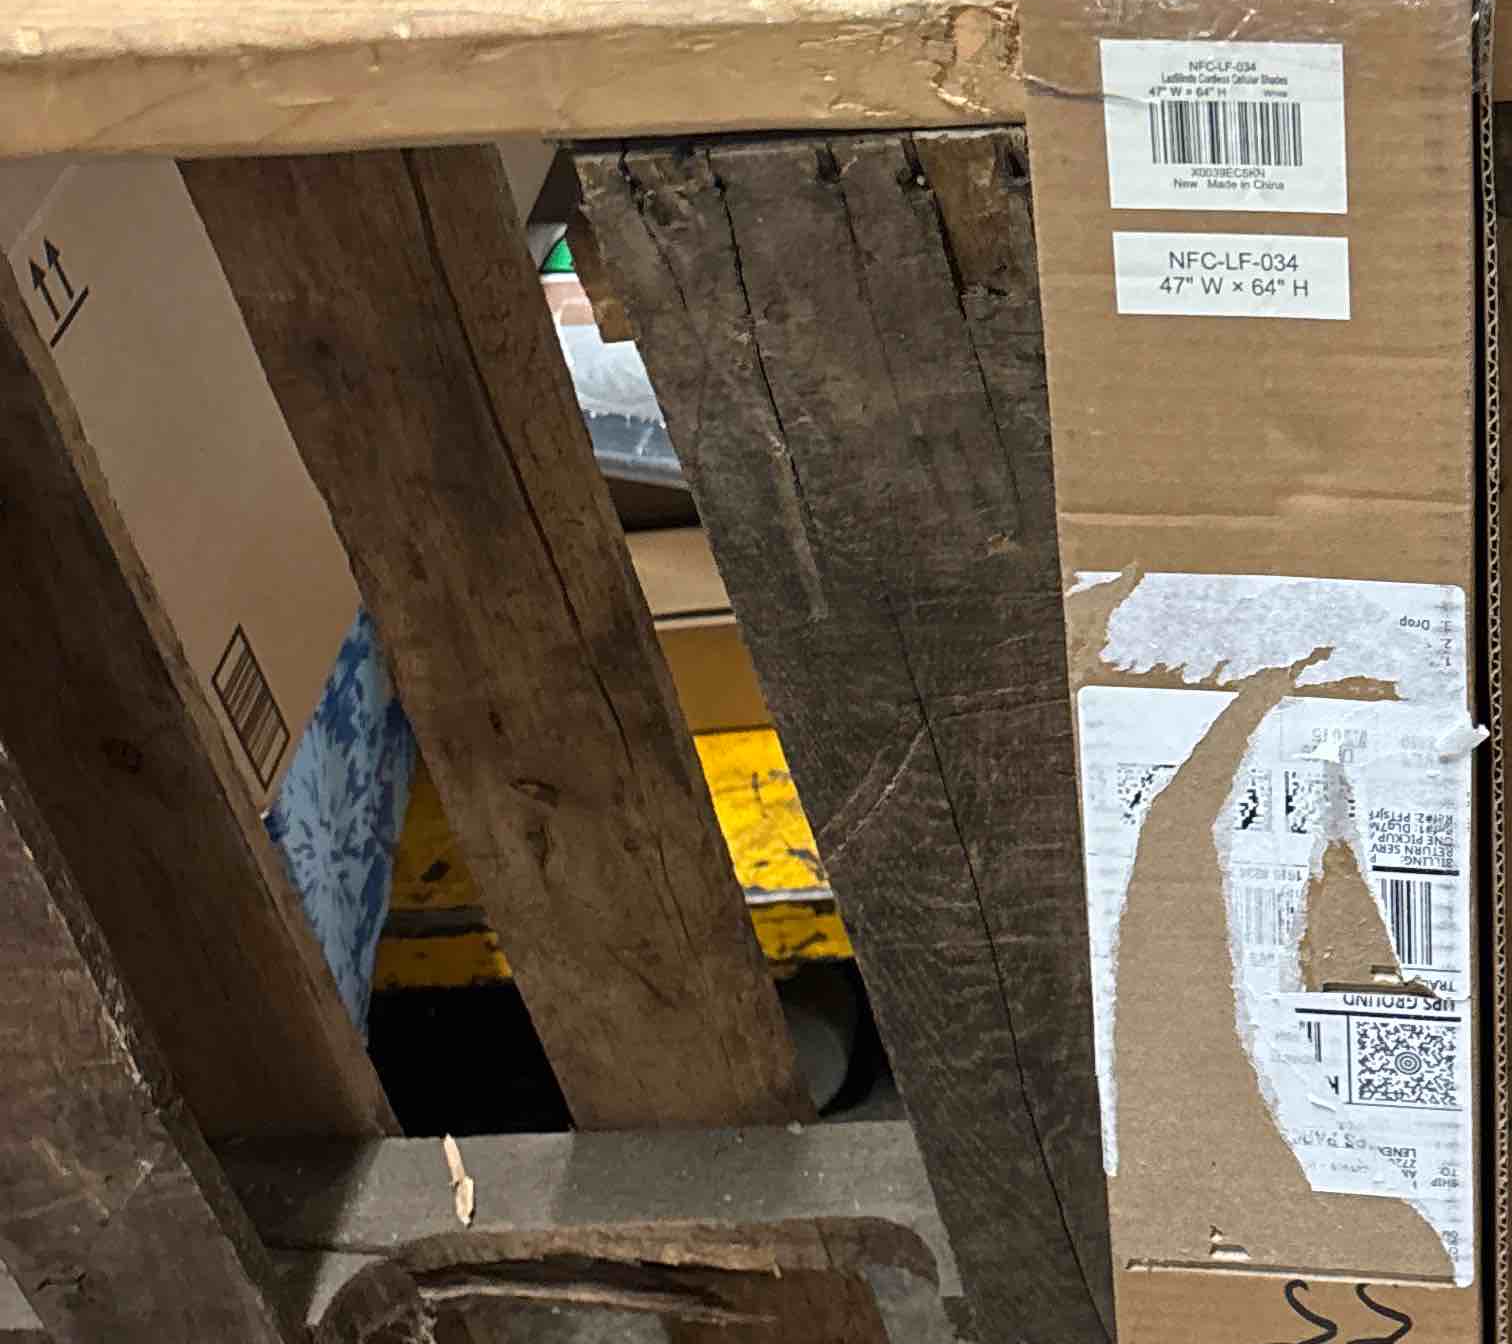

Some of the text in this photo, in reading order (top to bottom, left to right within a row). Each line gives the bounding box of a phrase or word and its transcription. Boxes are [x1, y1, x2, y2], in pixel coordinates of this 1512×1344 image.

[1189, 60, 1257, 73] NFC-LF-034
[1217, 87, 1227, 98] H
[1173, 177, 1286, 191] New Made in China
[1168, 250, 1300, 273] NFC-LF-034
[1159, 275, 1195, 295] 47"
[1200, 276, 1224, 295] W
[1251, 277, 1286, 297] 64"
[1292, 279, 1310, 297] H
[1399, 615, 1431, 631] Drop
[1378, 833, 1424, 846] PICKUP
[1405, 845, 1454, 858] RETURN
[1400, 855, 1454, 868] BILLING:
[1342, 994, 1456, 1012] UPS GROUND
